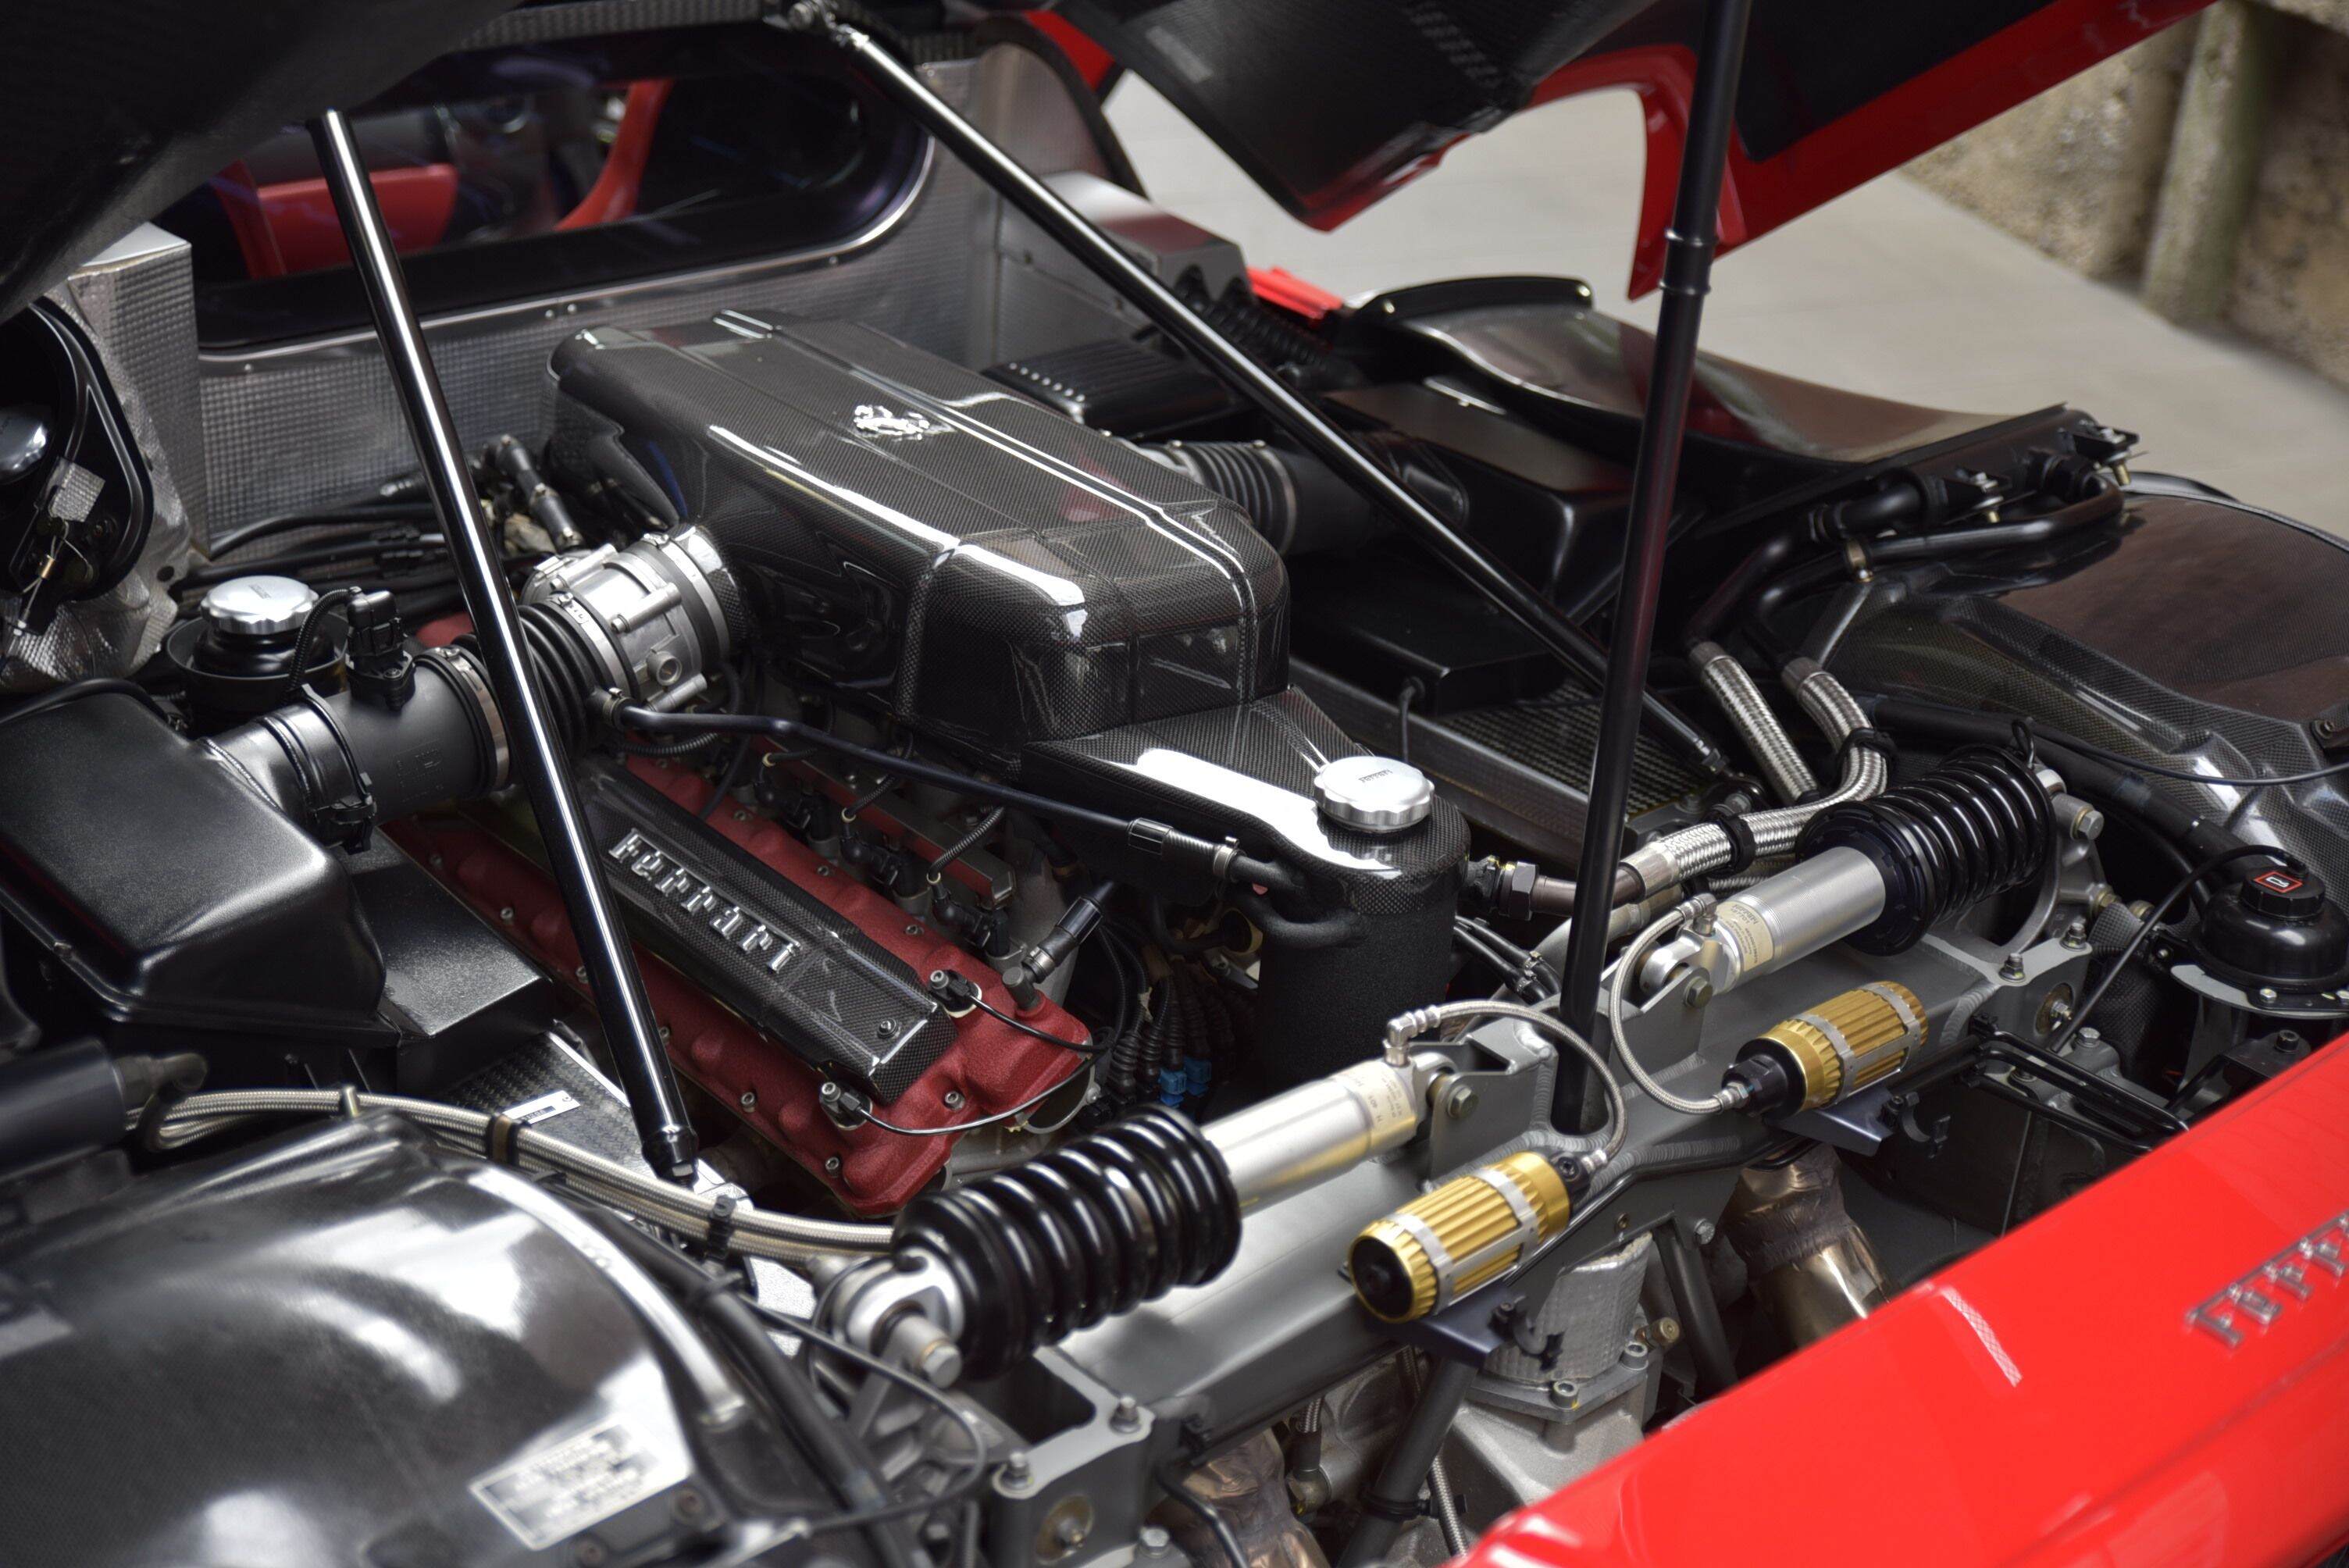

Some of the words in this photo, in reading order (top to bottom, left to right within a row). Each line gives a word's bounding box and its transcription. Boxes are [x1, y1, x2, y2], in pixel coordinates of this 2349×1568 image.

[1357, 768, 1394, 783] Ferrari
[608, 827, 802, 974] Ferrari
[2185, 1209, 2349, 1349] Ferr
